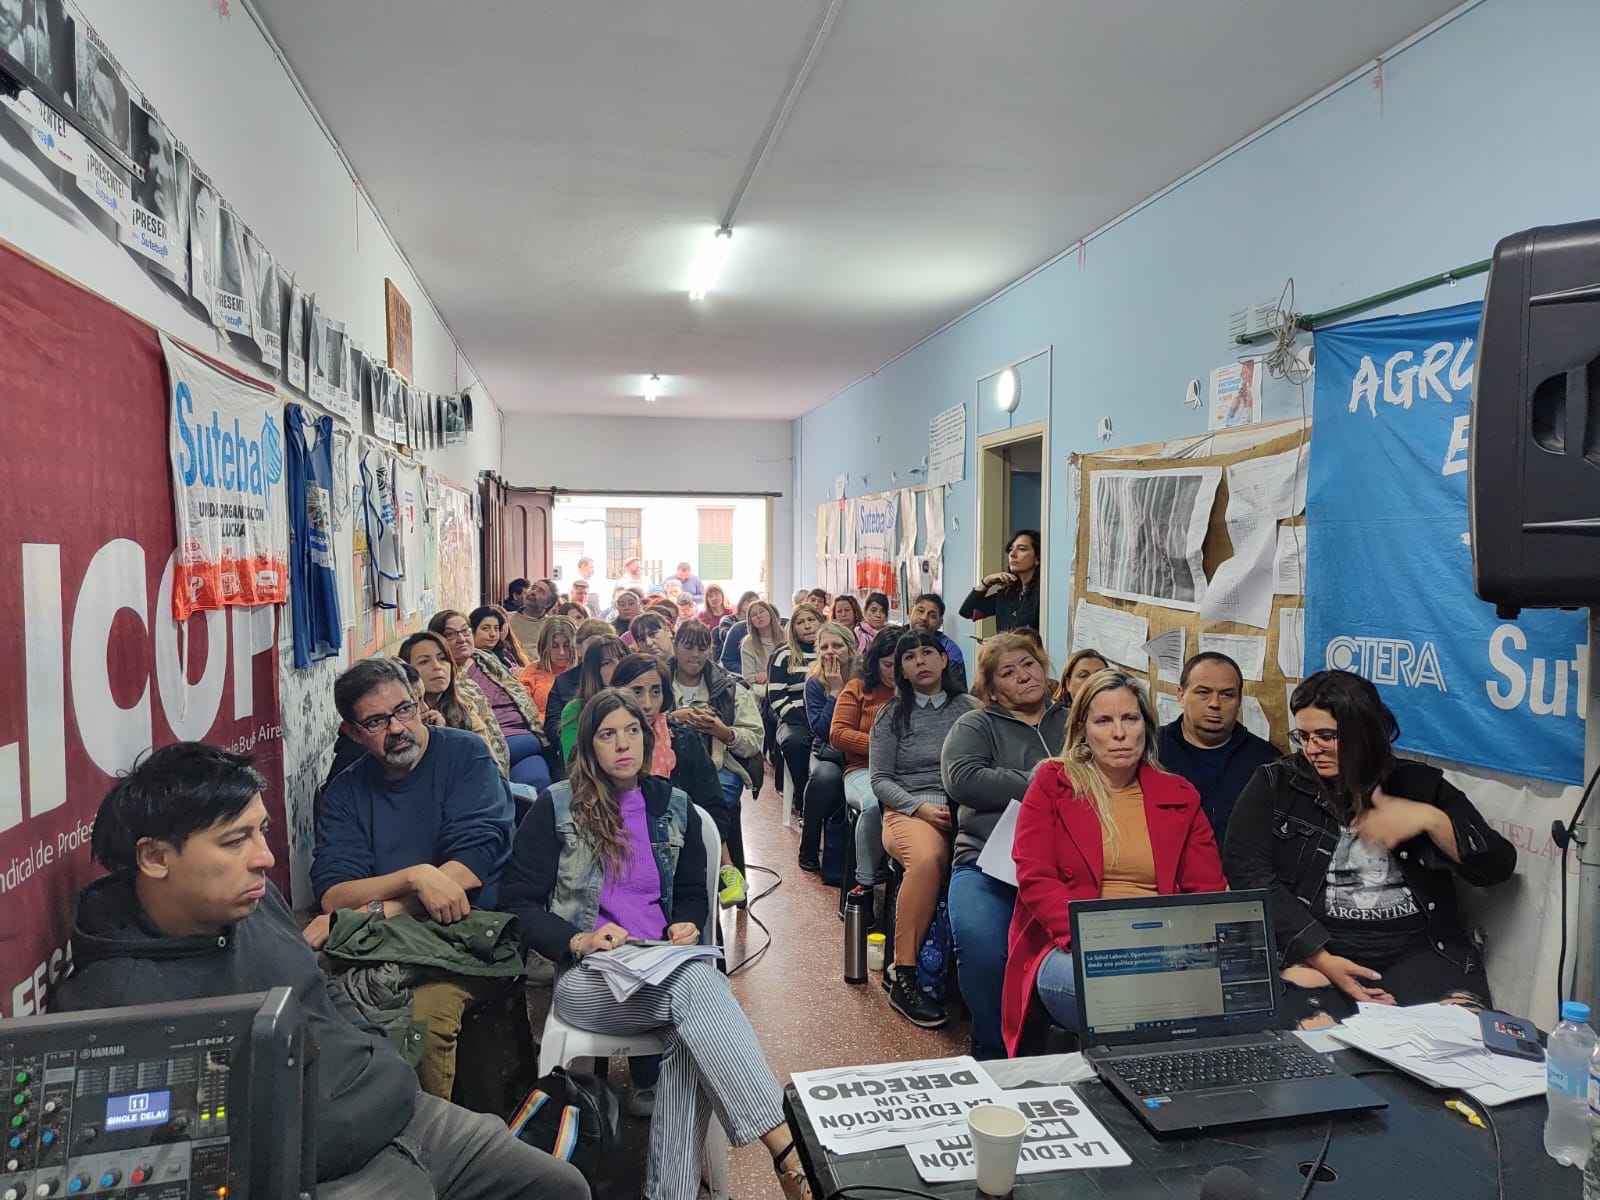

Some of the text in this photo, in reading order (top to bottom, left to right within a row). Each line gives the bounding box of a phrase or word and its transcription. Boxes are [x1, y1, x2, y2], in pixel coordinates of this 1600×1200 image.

[141, 232, 163, 255] Suteba
[175, 380, 263, 496] Suteba
[221, 523, 246, 537] LUCHA
[860, 505, 885, 535] Suteba
[1325, 635, 1448, 694] CTERA
[36, 840, 54, 869] de
[258, 723, 284, 742] Aires
[1327, 900, 1419, 921] ARGENTINA
[91, 1045, 125, 1058] YAMAHA
[808, 1069, 979, 1101] DERECHO
[874, 1091, 931, 1107] ES UN
[107, 1109, 168, 1125] SINGLE DELAY
[819, 1101, 963, 1131] EDUCACIÓN
[1072, 1140, 1111, 1157] LA
